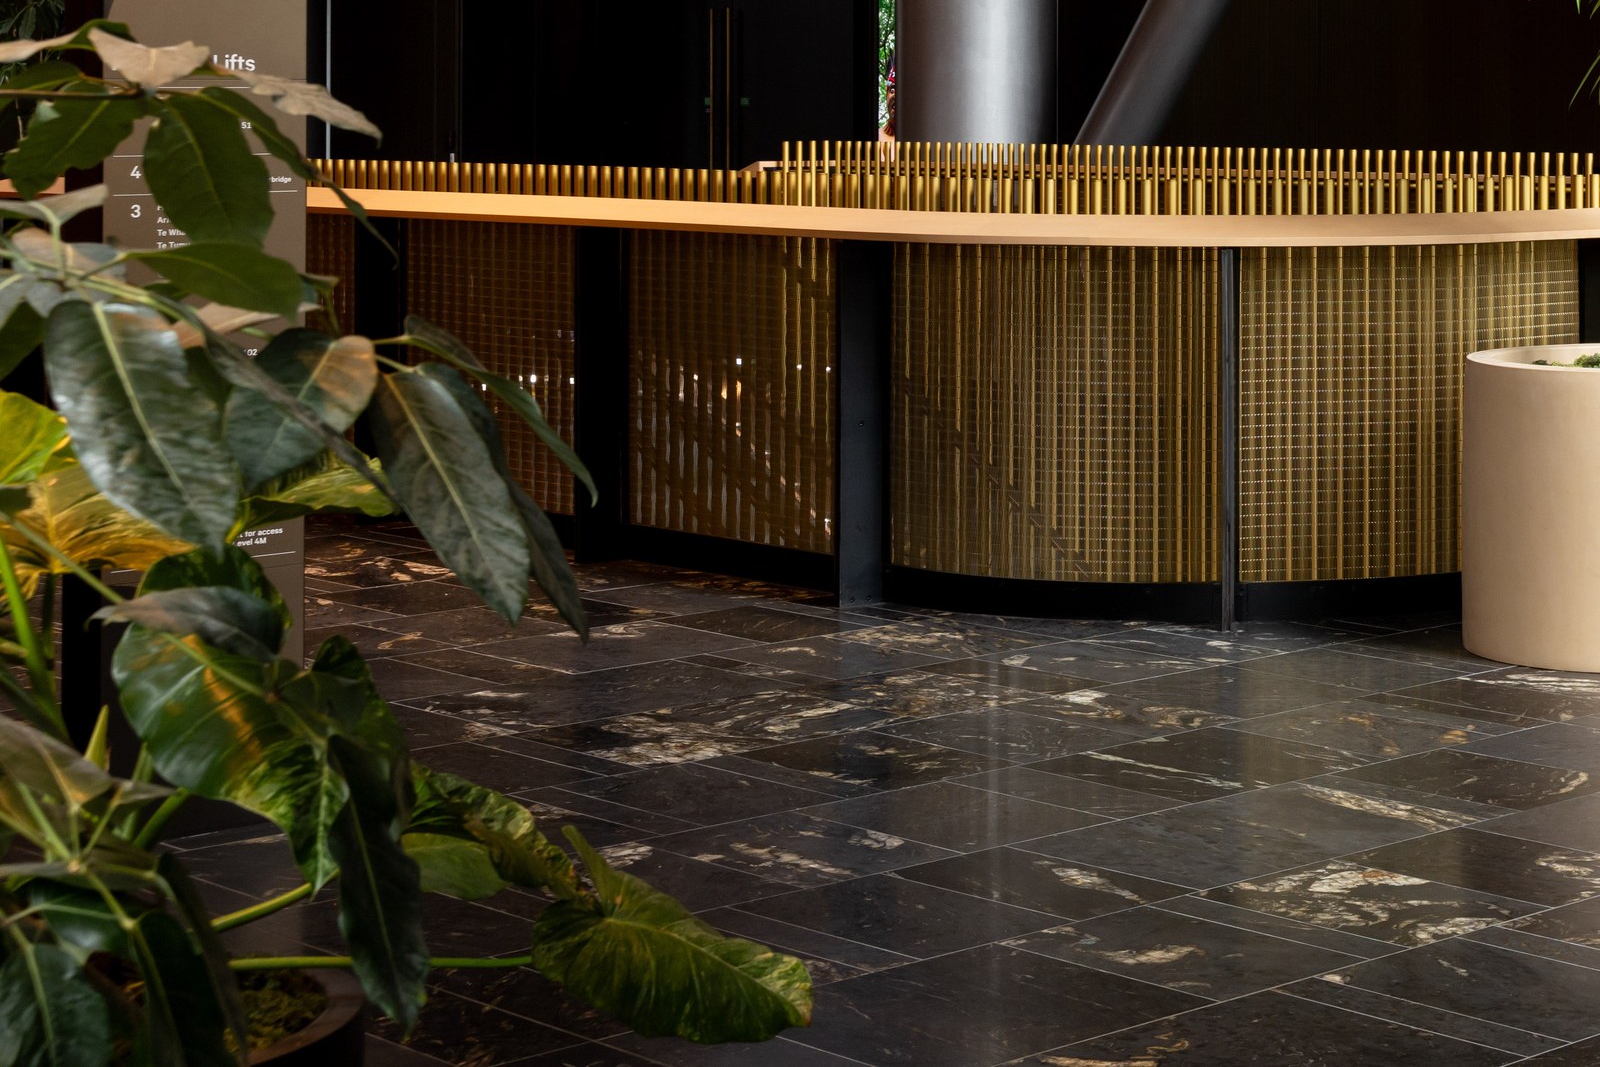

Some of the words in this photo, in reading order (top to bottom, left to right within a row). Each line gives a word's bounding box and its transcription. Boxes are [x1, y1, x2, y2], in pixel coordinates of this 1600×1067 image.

[130, 166, 142, 179] 4
[269, 176, 292, 184] bridge
[130, 204, 142, 219] 3
[156, 229, 167, 237] Te
[156, 241, 167, 249] Te
[243, 348, 258, 356] 02
[257, 528, 283, 536] access
[232, 539, 253, 547] evel
[254, 537, 267, 545] 4M
